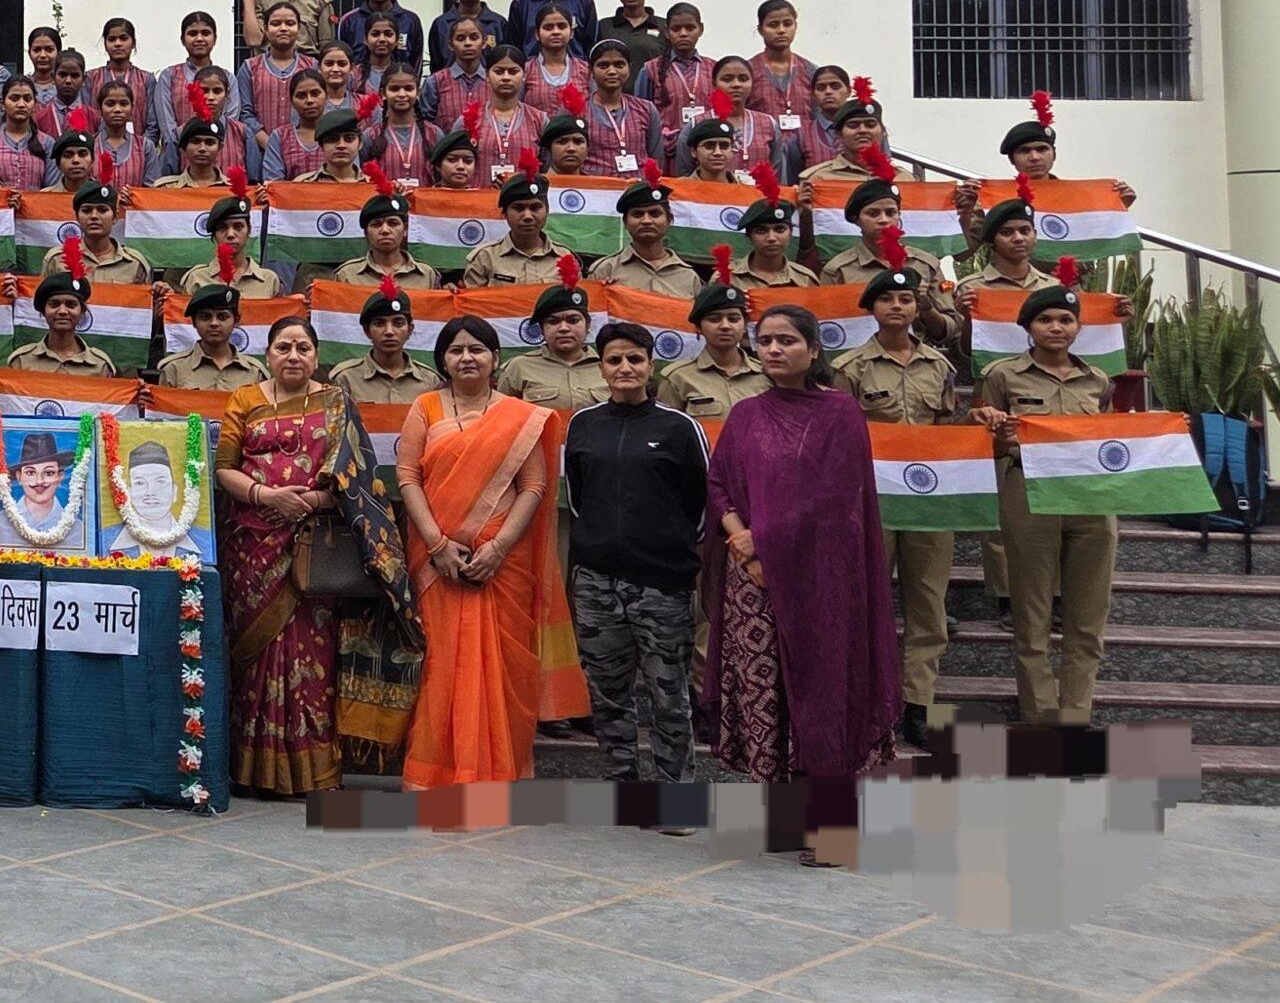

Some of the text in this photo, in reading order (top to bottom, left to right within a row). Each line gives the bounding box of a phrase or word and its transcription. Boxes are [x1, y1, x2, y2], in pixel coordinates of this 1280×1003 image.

[1, 584, 38, 628] दिवस
[52, 591, 139, 635] 23 मार्च
